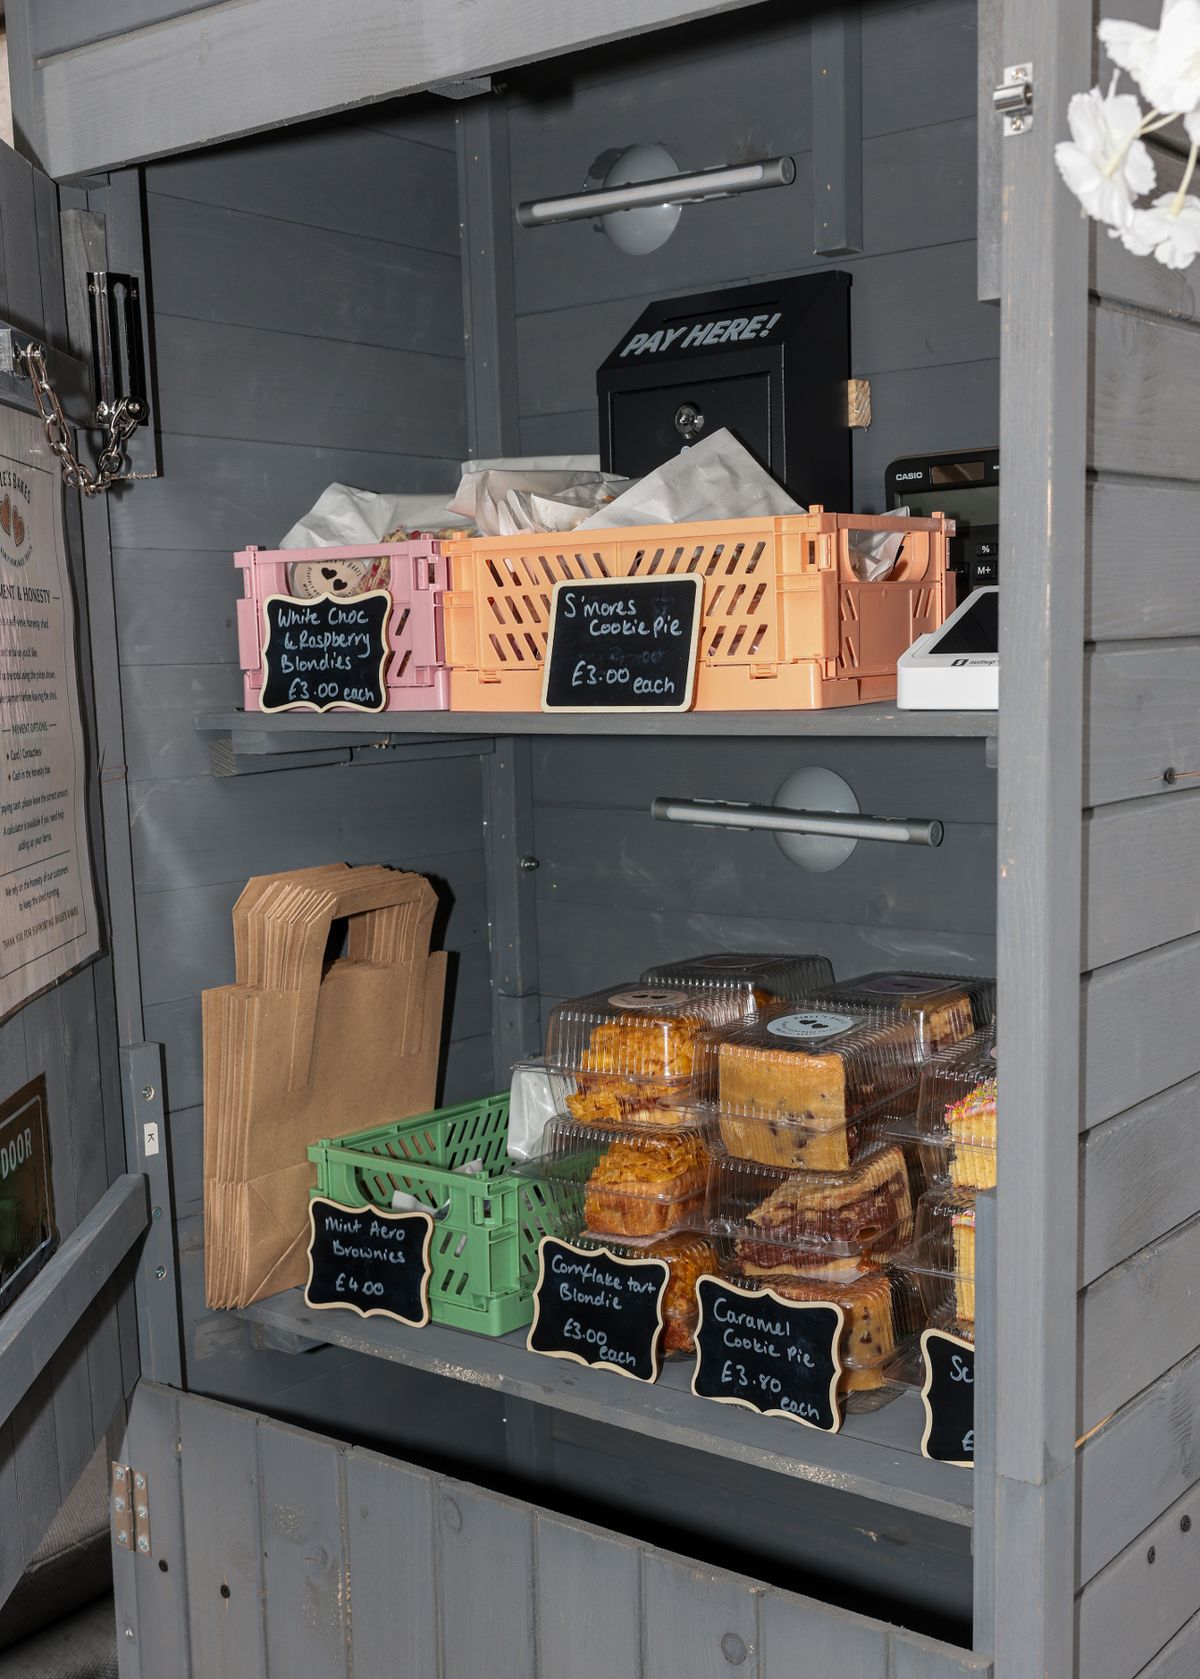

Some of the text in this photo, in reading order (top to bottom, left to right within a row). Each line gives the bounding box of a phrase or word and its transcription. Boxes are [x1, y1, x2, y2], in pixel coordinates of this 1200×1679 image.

[620, 312, 782, 358] PAY HERE!
[12, 472, 31, 504] BAKES
[896, 472, 922, 480] CASIO
[982, 545, 990, 553] %
[978, 566, 991, 575] M+
[23, 586, 50, 603] HONESTY
[564, 593, 636, 618] S'mores
[278, 608, 368, 628] White Choc
[590, 618, 650, 636] Cookie
[300, 630, 370, 658] Raspberry
[281, 654, 351, 673] Blondies
[572, 660, 674, 693] £3.00 each
[288, 678, 375, 702] £3.00 each
[12, 722, 48, 735] PAYMENT OPTIONS
[1, 1128, 32, 1179] DOOR
[325, 1216, 405, 1241] Mint Aero
[333, 1240, 405, 1264] Brownies
[552, 1254, 656, 1293] Cornflake tart
[560, 1282, 622, 1310] Blondie
[713, 1297, 790, 1336] Caramel
[563, 1317, 607, 1346] £3.00
[723, 1328, 781, 1357] Cookie
[599, 1345, 636, 1366] each
[722, 1360, 782, 1393] £3.80
[780, 1396, 820, 1420] each
